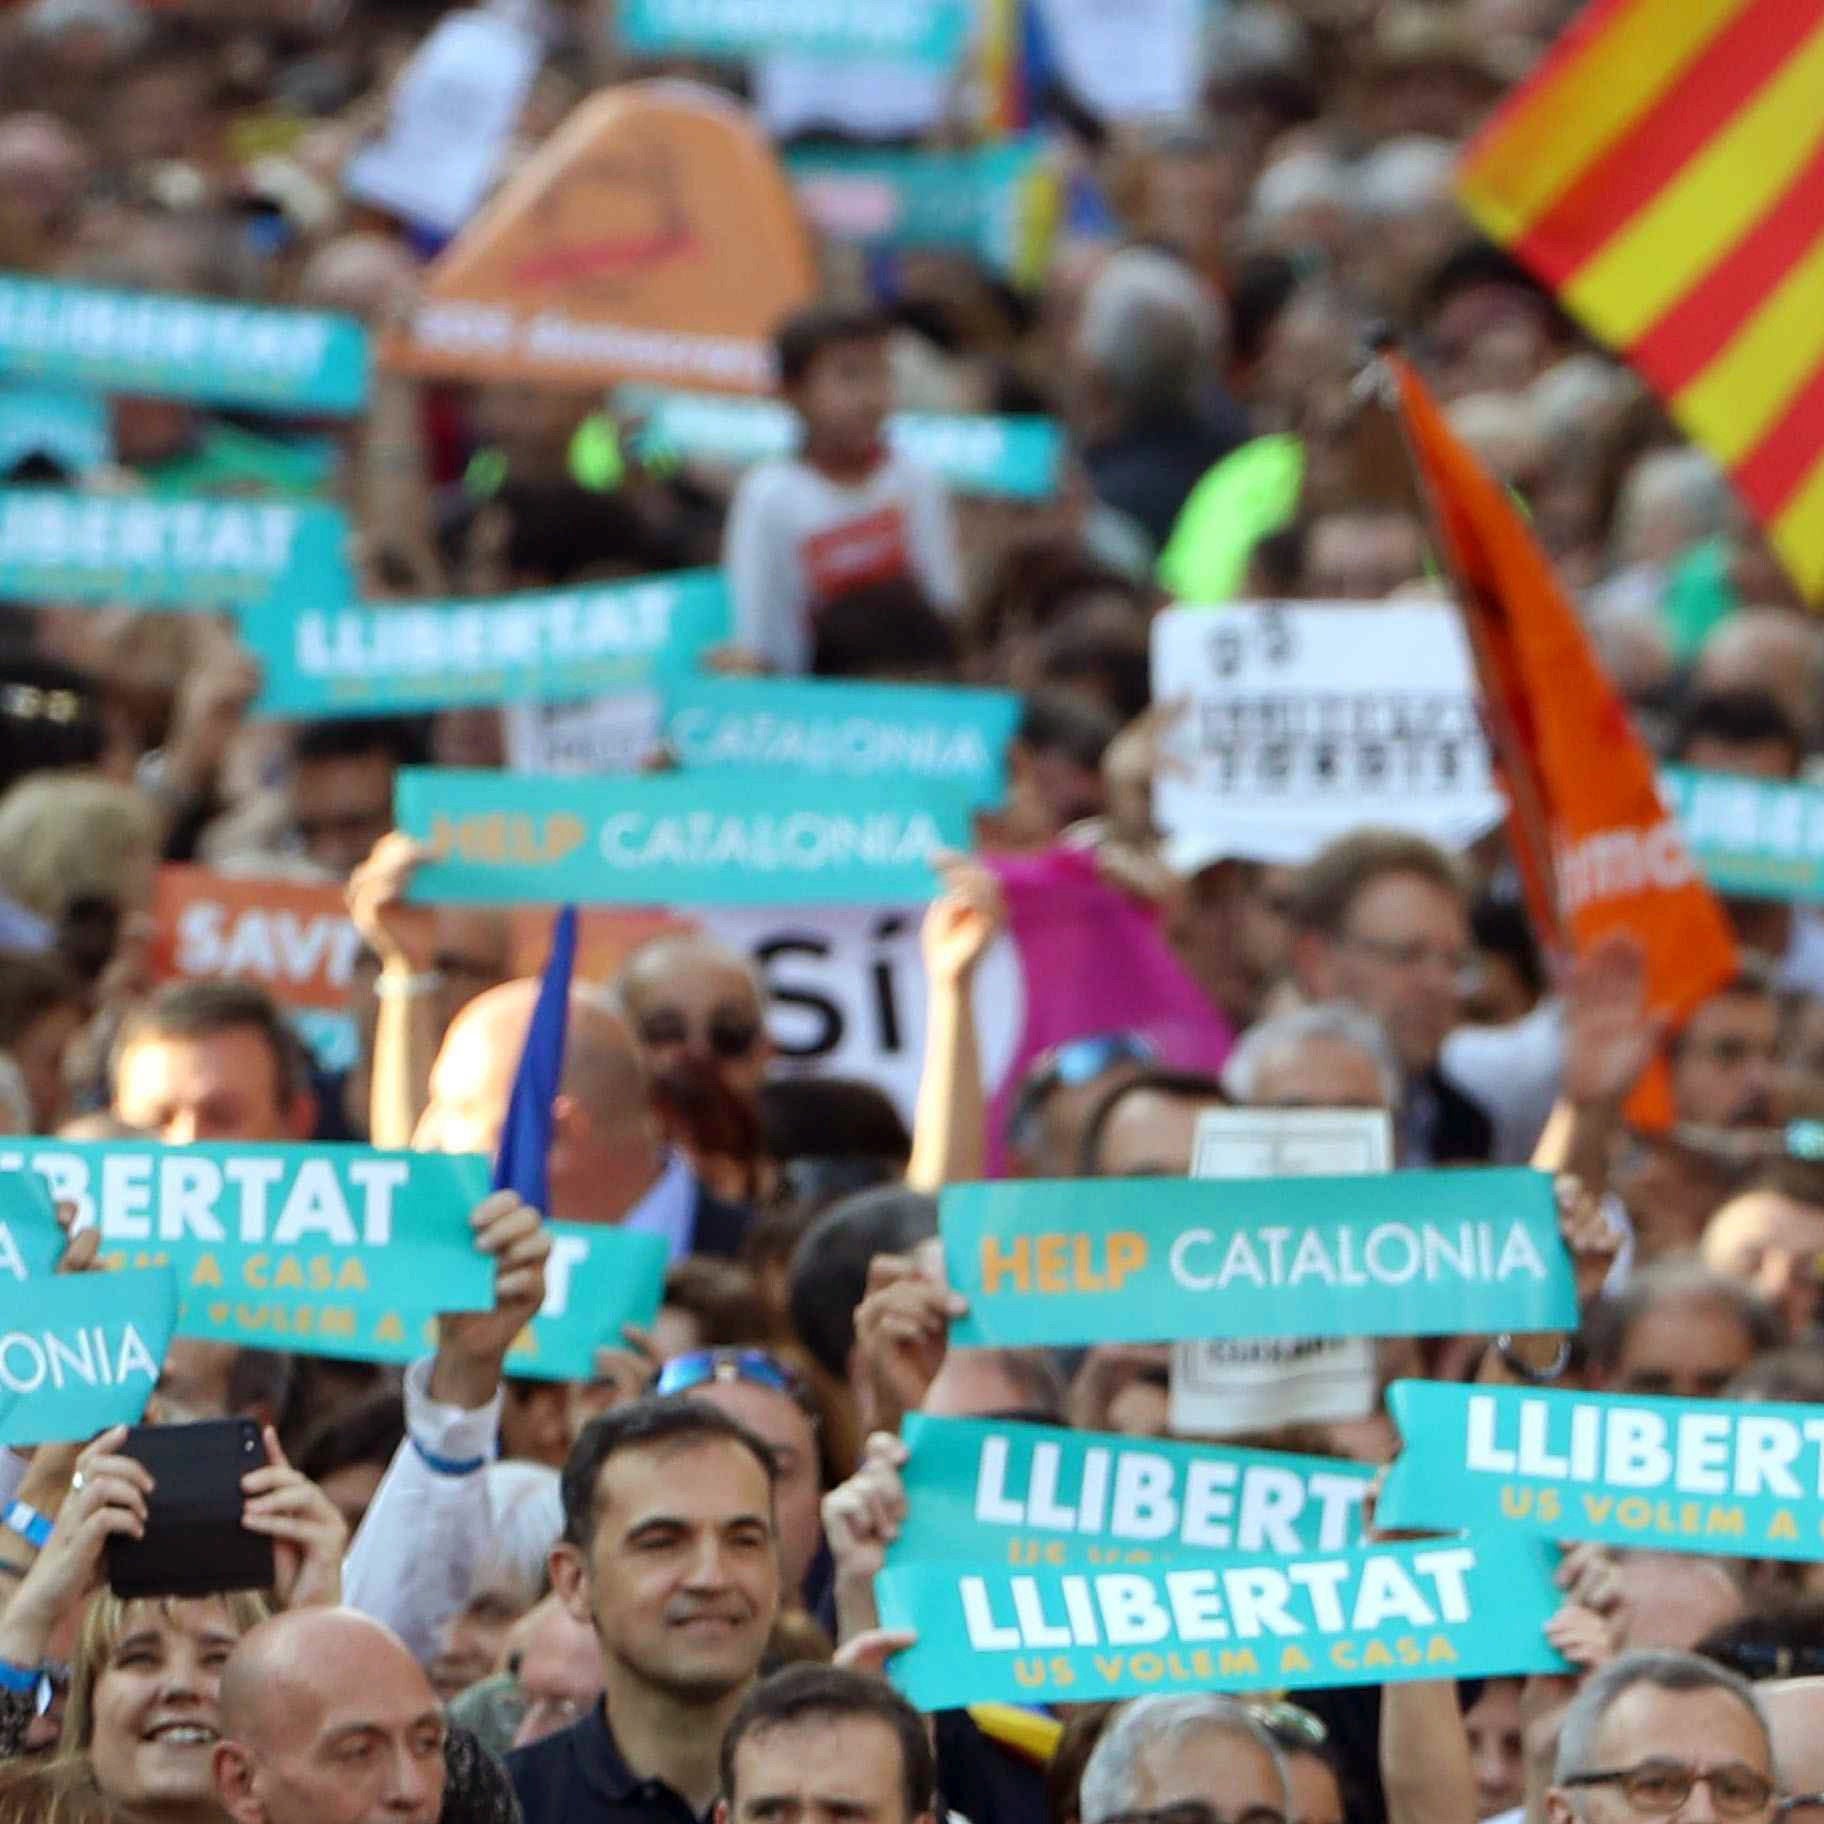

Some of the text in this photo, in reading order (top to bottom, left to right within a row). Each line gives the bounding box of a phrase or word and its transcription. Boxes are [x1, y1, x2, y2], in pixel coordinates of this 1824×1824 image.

[602, 810, 946, 872] CATALONIA
[0, 1150, 410, 1248] BERTAT
[192, 1254, 223, 1288] A
[243, 1255, 368, 1290] CASA
[981, 1220, 1548, 1294] HELP CATALONIA
[974, 1434, 1375, 1555] LLIBERT
[1502, 1486, 1562, 1522] US
[1583, 1492, 1748, 1536] VOLEM
[1766, 1506, 1799, 1540] A
[959, 1547, 1479, 1653] LLIBERTAT
[1013, 1633, 1460, 1689] US VOLEM A CASA
